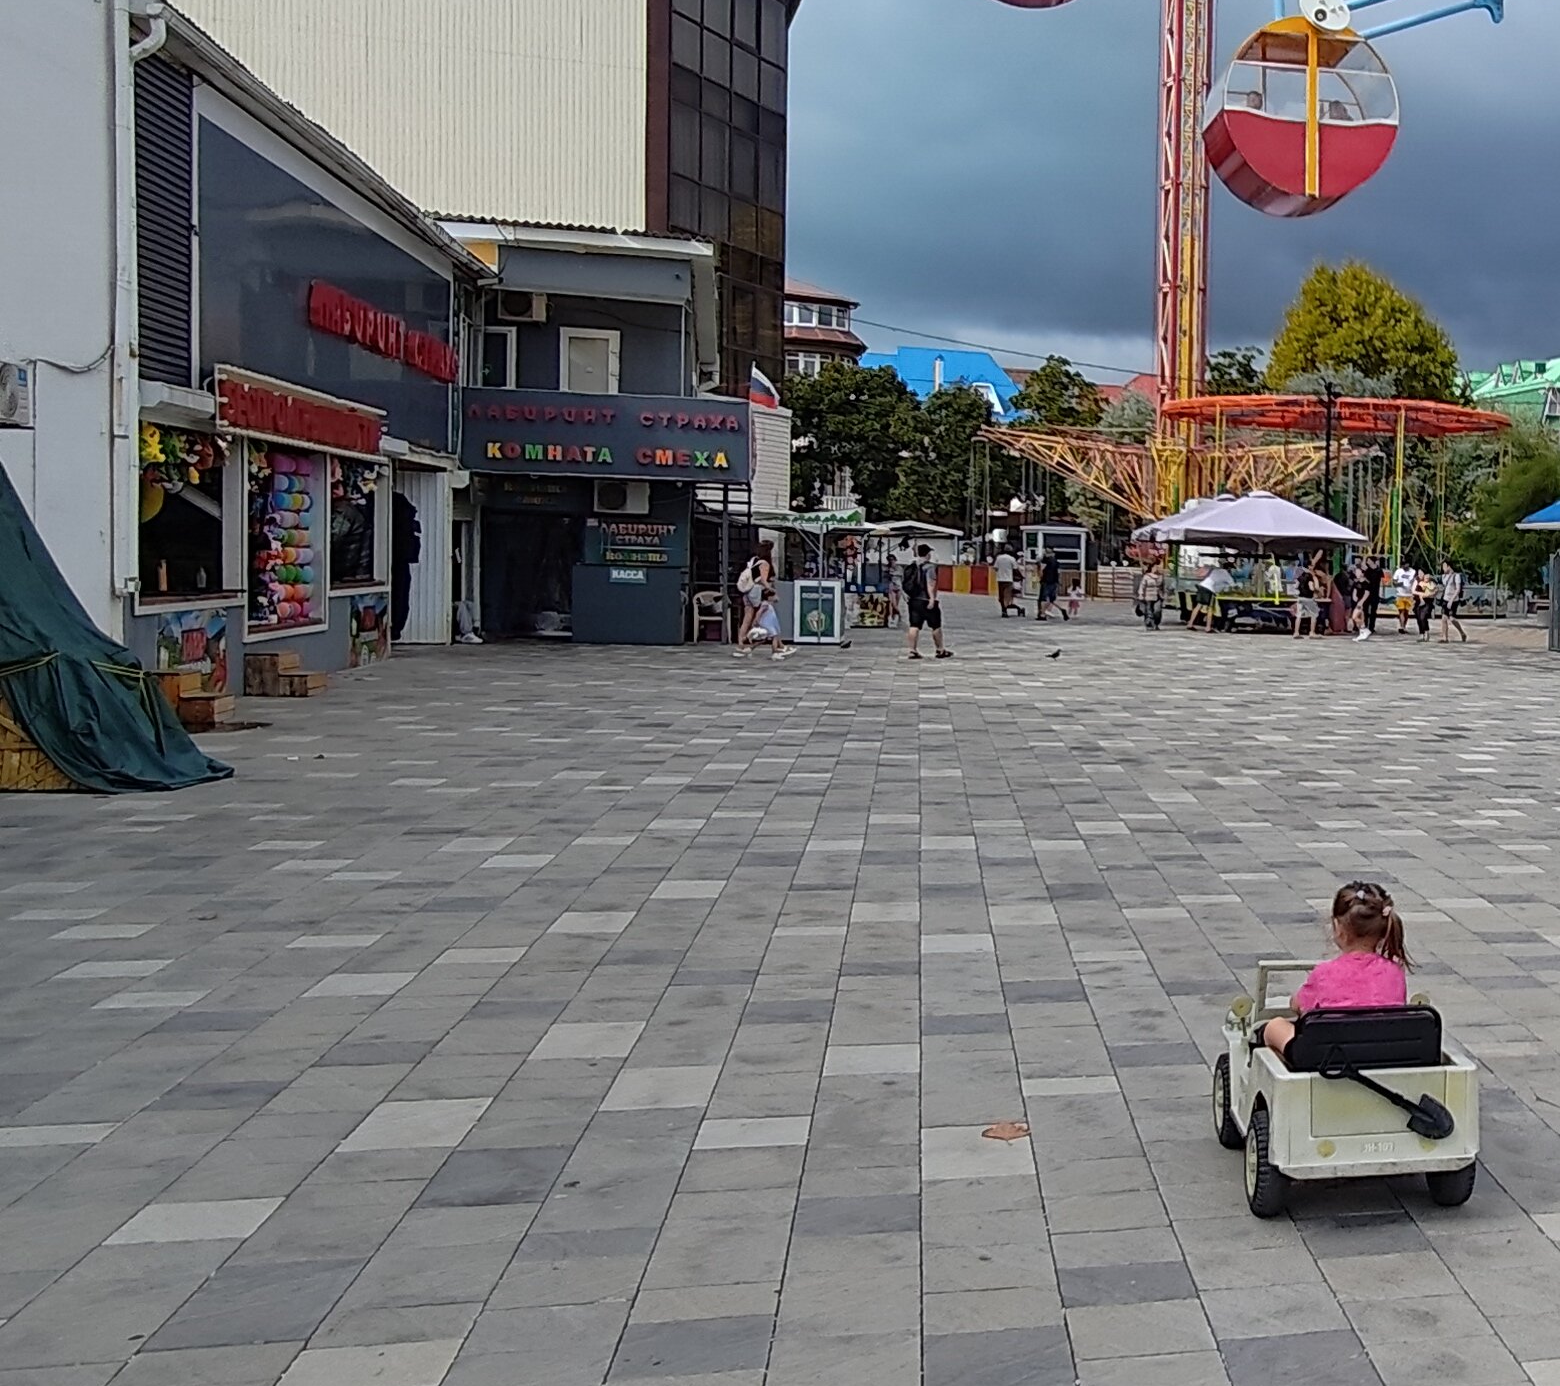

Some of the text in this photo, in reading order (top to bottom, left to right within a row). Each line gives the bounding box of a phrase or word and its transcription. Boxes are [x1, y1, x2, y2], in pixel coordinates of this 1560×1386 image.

[468, 404, 740, 432] ЛАБИРИНТ СТРАХА
[486, 442, 729, 469] КОМНАТА СМЕХА
[611, 569, 645, 580] КАССА
